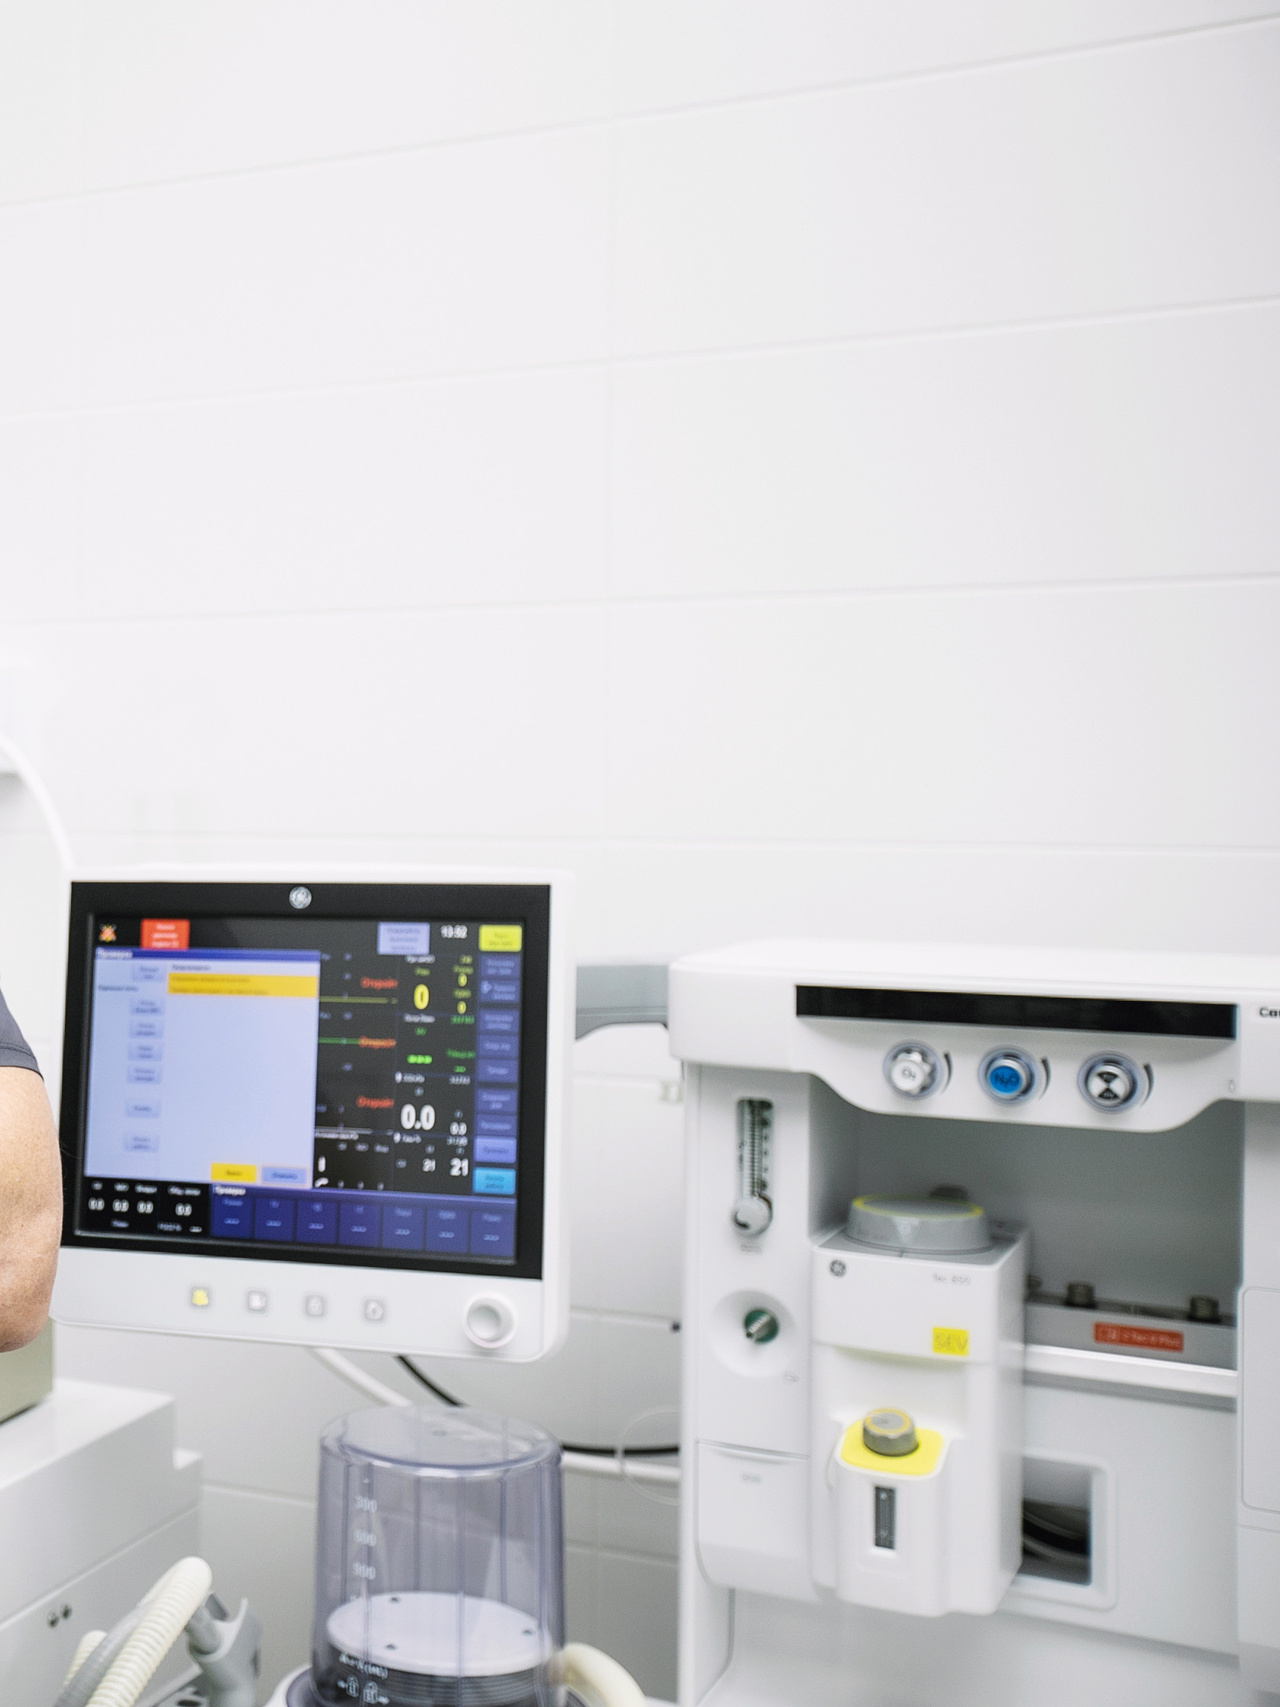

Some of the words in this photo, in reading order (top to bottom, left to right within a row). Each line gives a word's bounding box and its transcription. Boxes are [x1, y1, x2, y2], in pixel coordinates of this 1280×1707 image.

[414, 984, 429, 1010] 0
[401, 1104, 435, 1130] 0.0
[450, 1157, 469, 1176] 21
